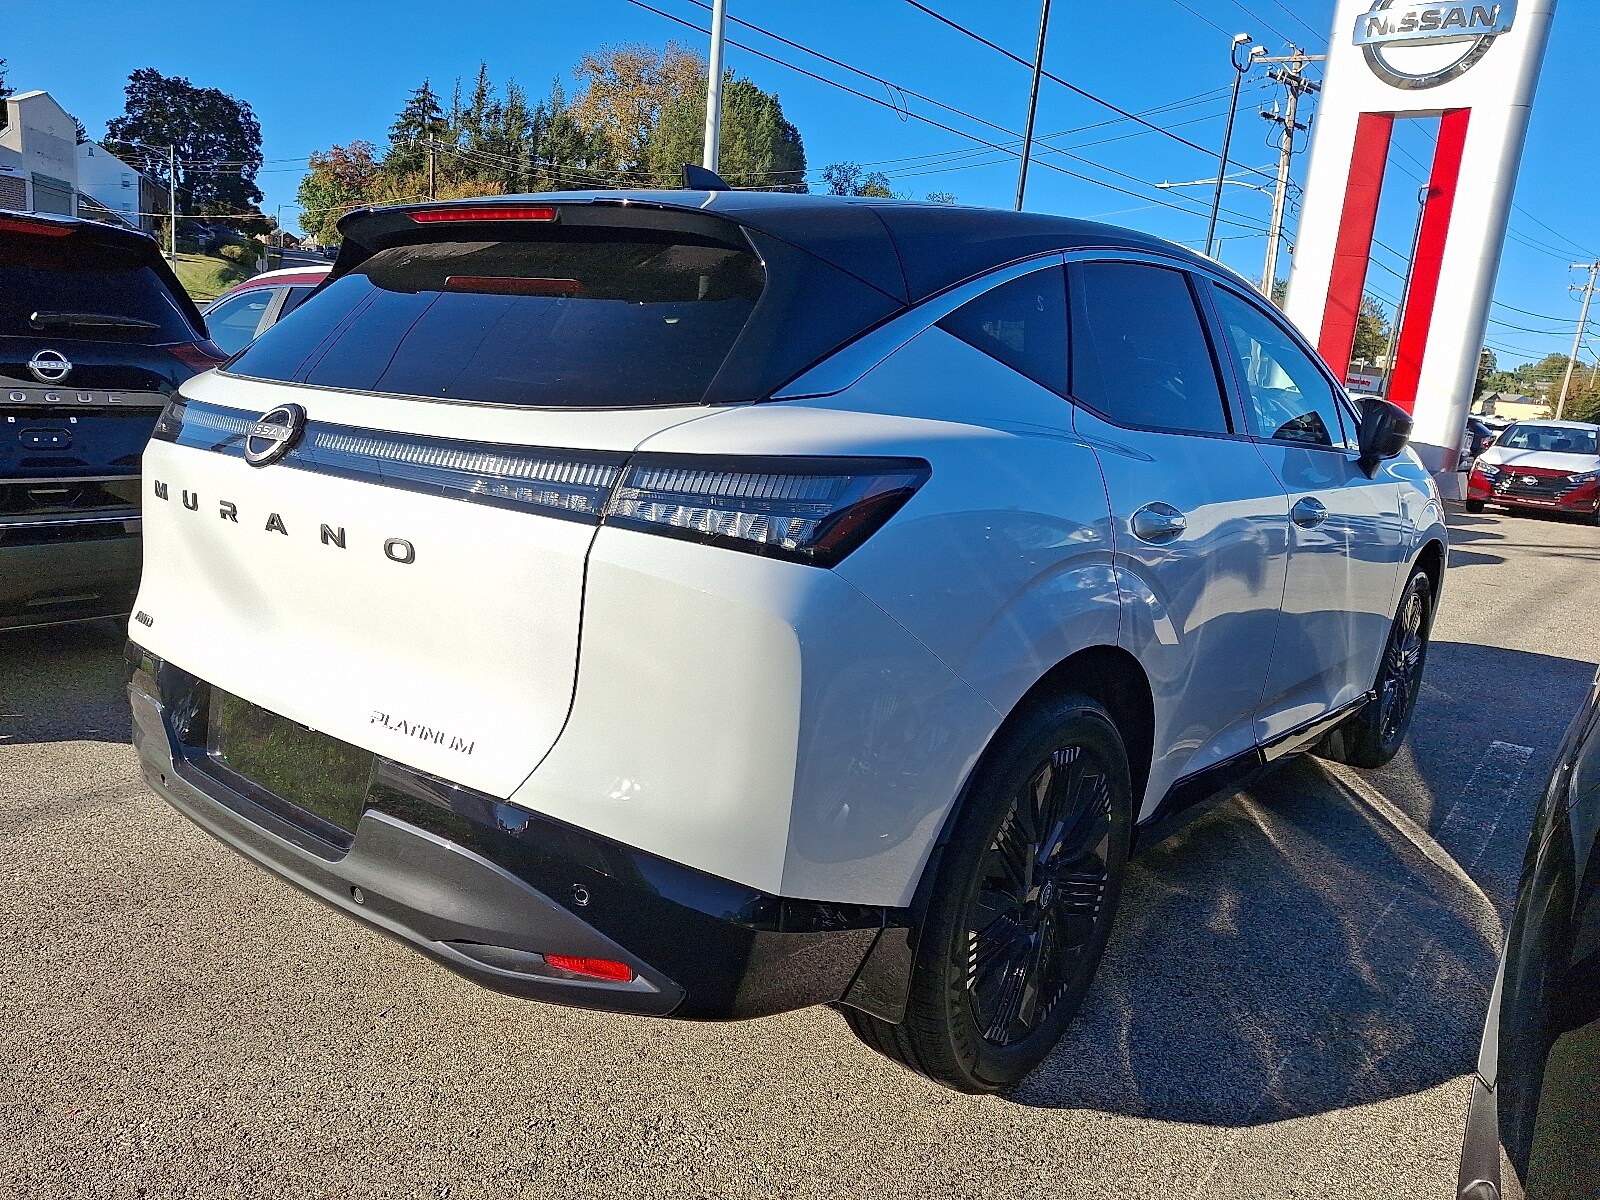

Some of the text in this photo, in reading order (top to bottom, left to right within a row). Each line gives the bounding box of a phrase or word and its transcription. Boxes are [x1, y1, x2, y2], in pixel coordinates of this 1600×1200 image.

[1366, 5, 1499, 37] NISSAN
[28, 361, 72, 369] NISSAN
[247, 423, 292, 438] NISSAN
[154, 479, 416, 564] MURANO
[134, 610, 154, 627] AWD
[369, 709, 476, 755] PLATINUM
